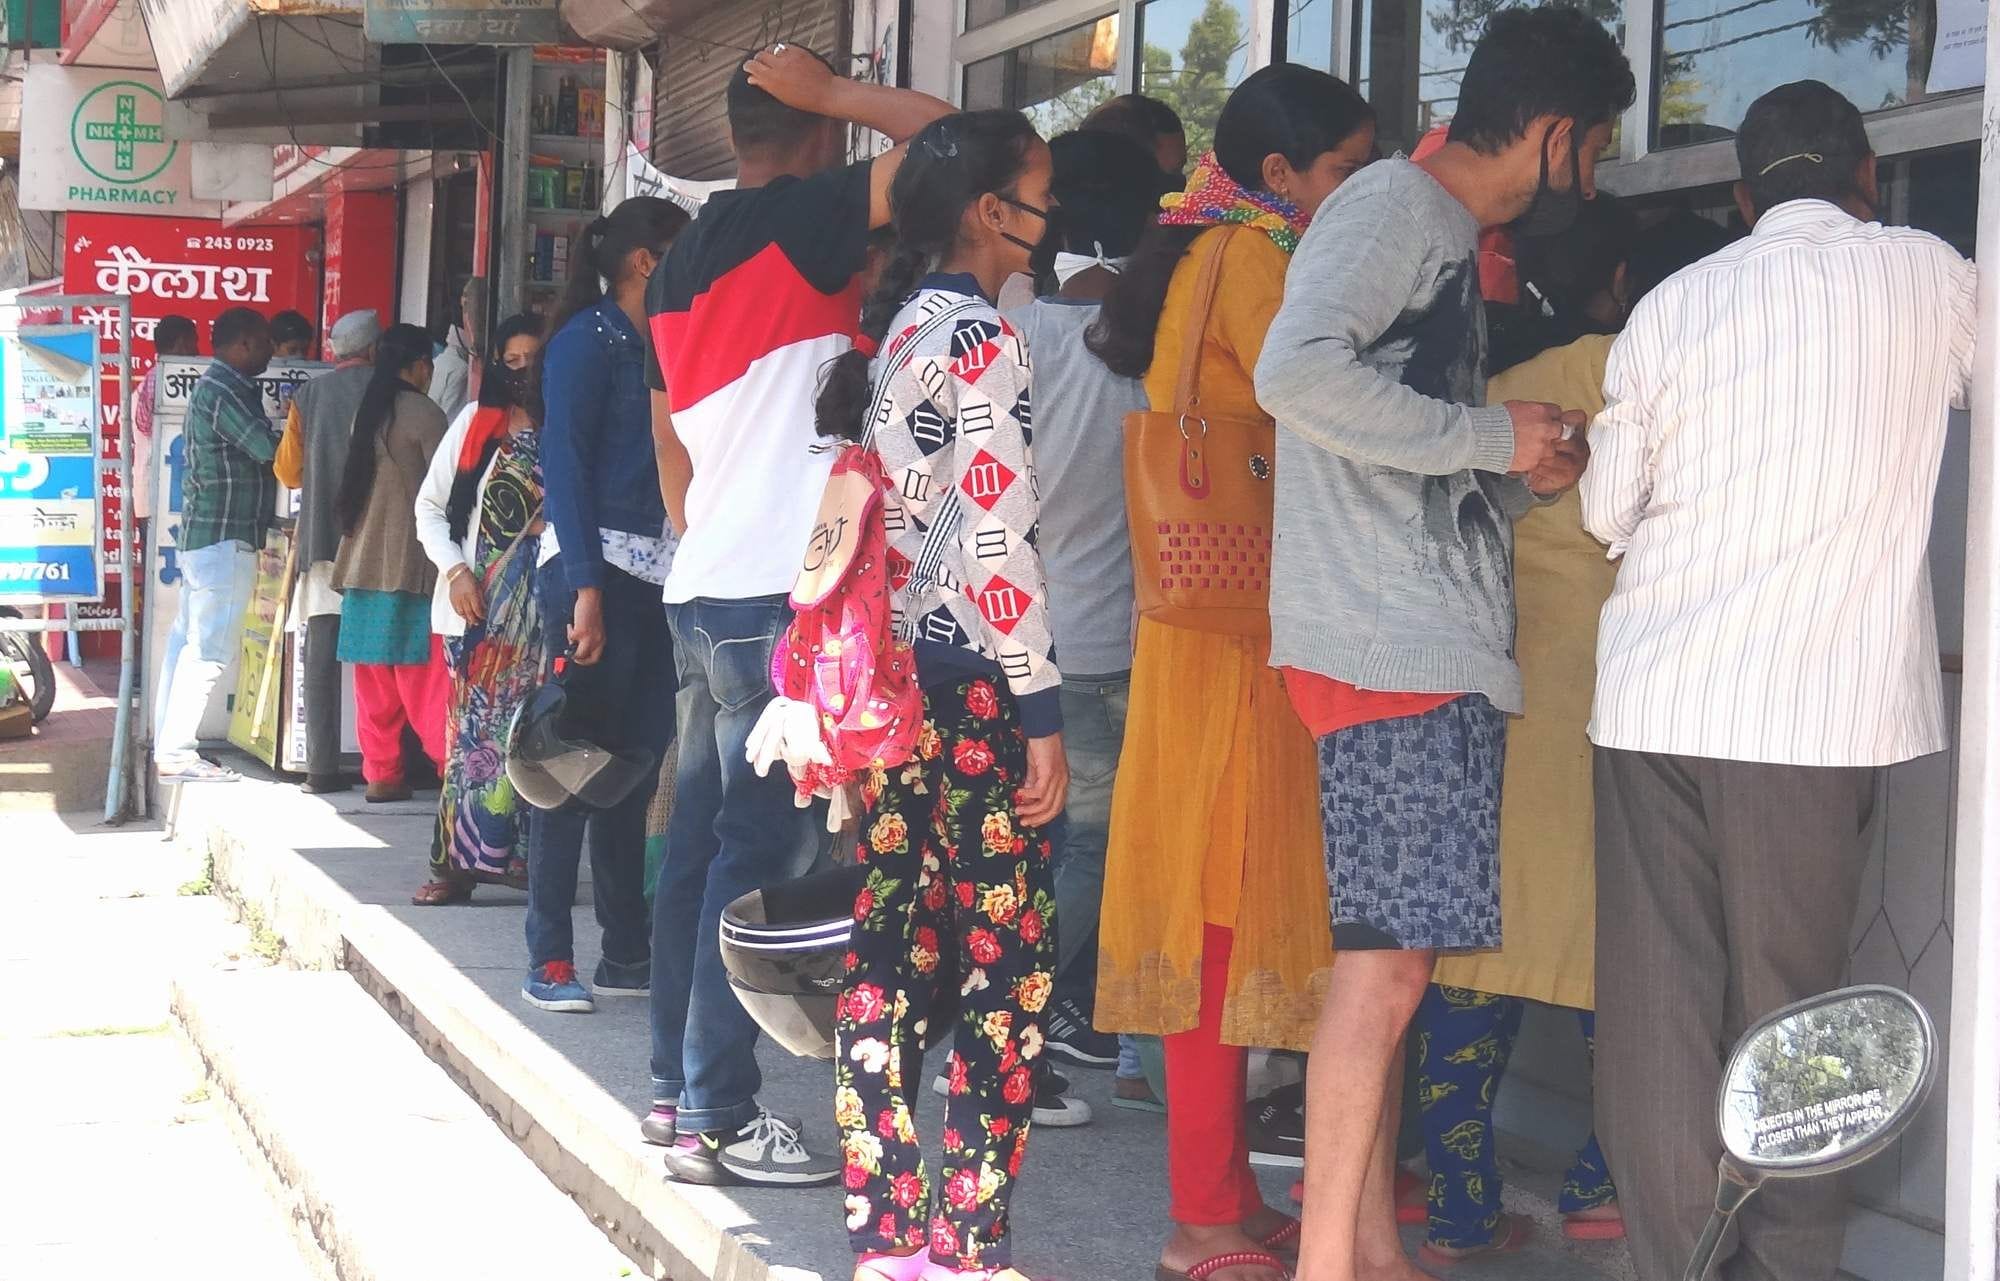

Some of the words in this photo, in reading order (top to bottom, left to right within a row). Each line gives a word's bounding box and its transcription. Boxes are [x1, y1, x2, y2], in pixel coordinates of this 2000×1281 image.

[69, 186, 177, 204] PHARMACY
[205, 237, 232, 250] 243
[237, 238, 274, 252] 0923
[95, 245, 273, 302] कैलाश
[1260, 1105, 1277, 1123] AIR
[1754, 1111, 1794, 1133] OBJECTS
[1794, 1109, 1804, 1123] IN
[1804, 1103, 1824, 1118] THE
[1824, 1094, 1862, 1114] MIRROR
[1862, 1089, 1882, 1106] ARE
[1758, 1128, 1795, 1148] CLOSER
[1794, 1121, 1820, 1140] THAN
[1820, 1113, 1846, 1132] THEY
[1846, 1105, 1883, 1126] APPEAR
